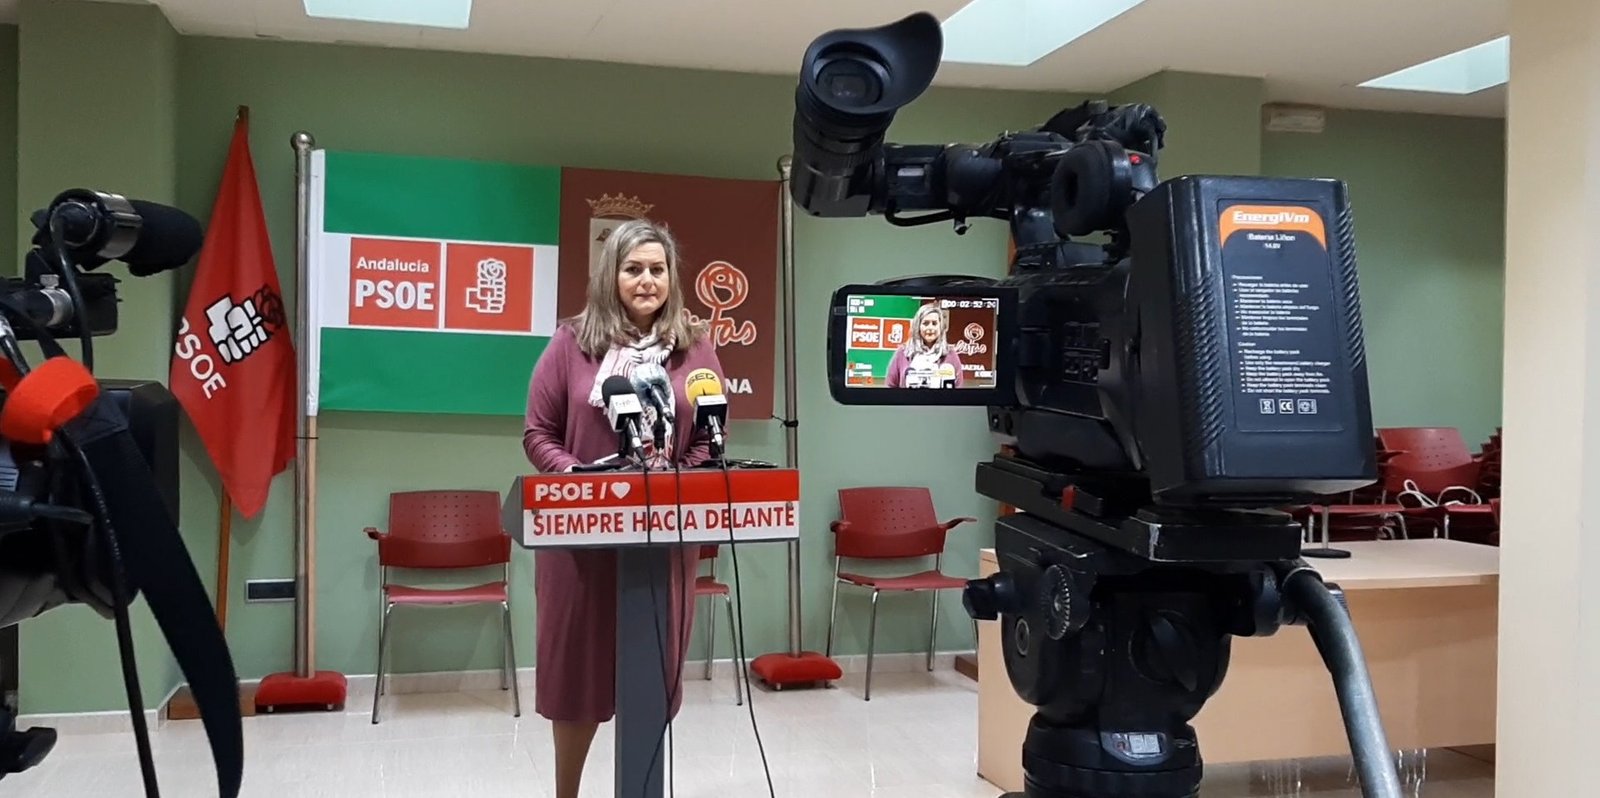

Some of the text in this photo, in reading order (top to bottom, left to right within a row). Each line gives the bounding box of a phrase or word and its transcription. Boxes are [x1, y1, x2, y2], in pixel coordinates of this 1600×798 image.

[355, 279, 435, 310] PSOE
[852, 331, 880, 343] PSOE
[725, 379, 753, 394] NA
[535, 482, 593, 501] PSOE
[533, 505, 795, 536] SIEMPRE HACA DELANTE
